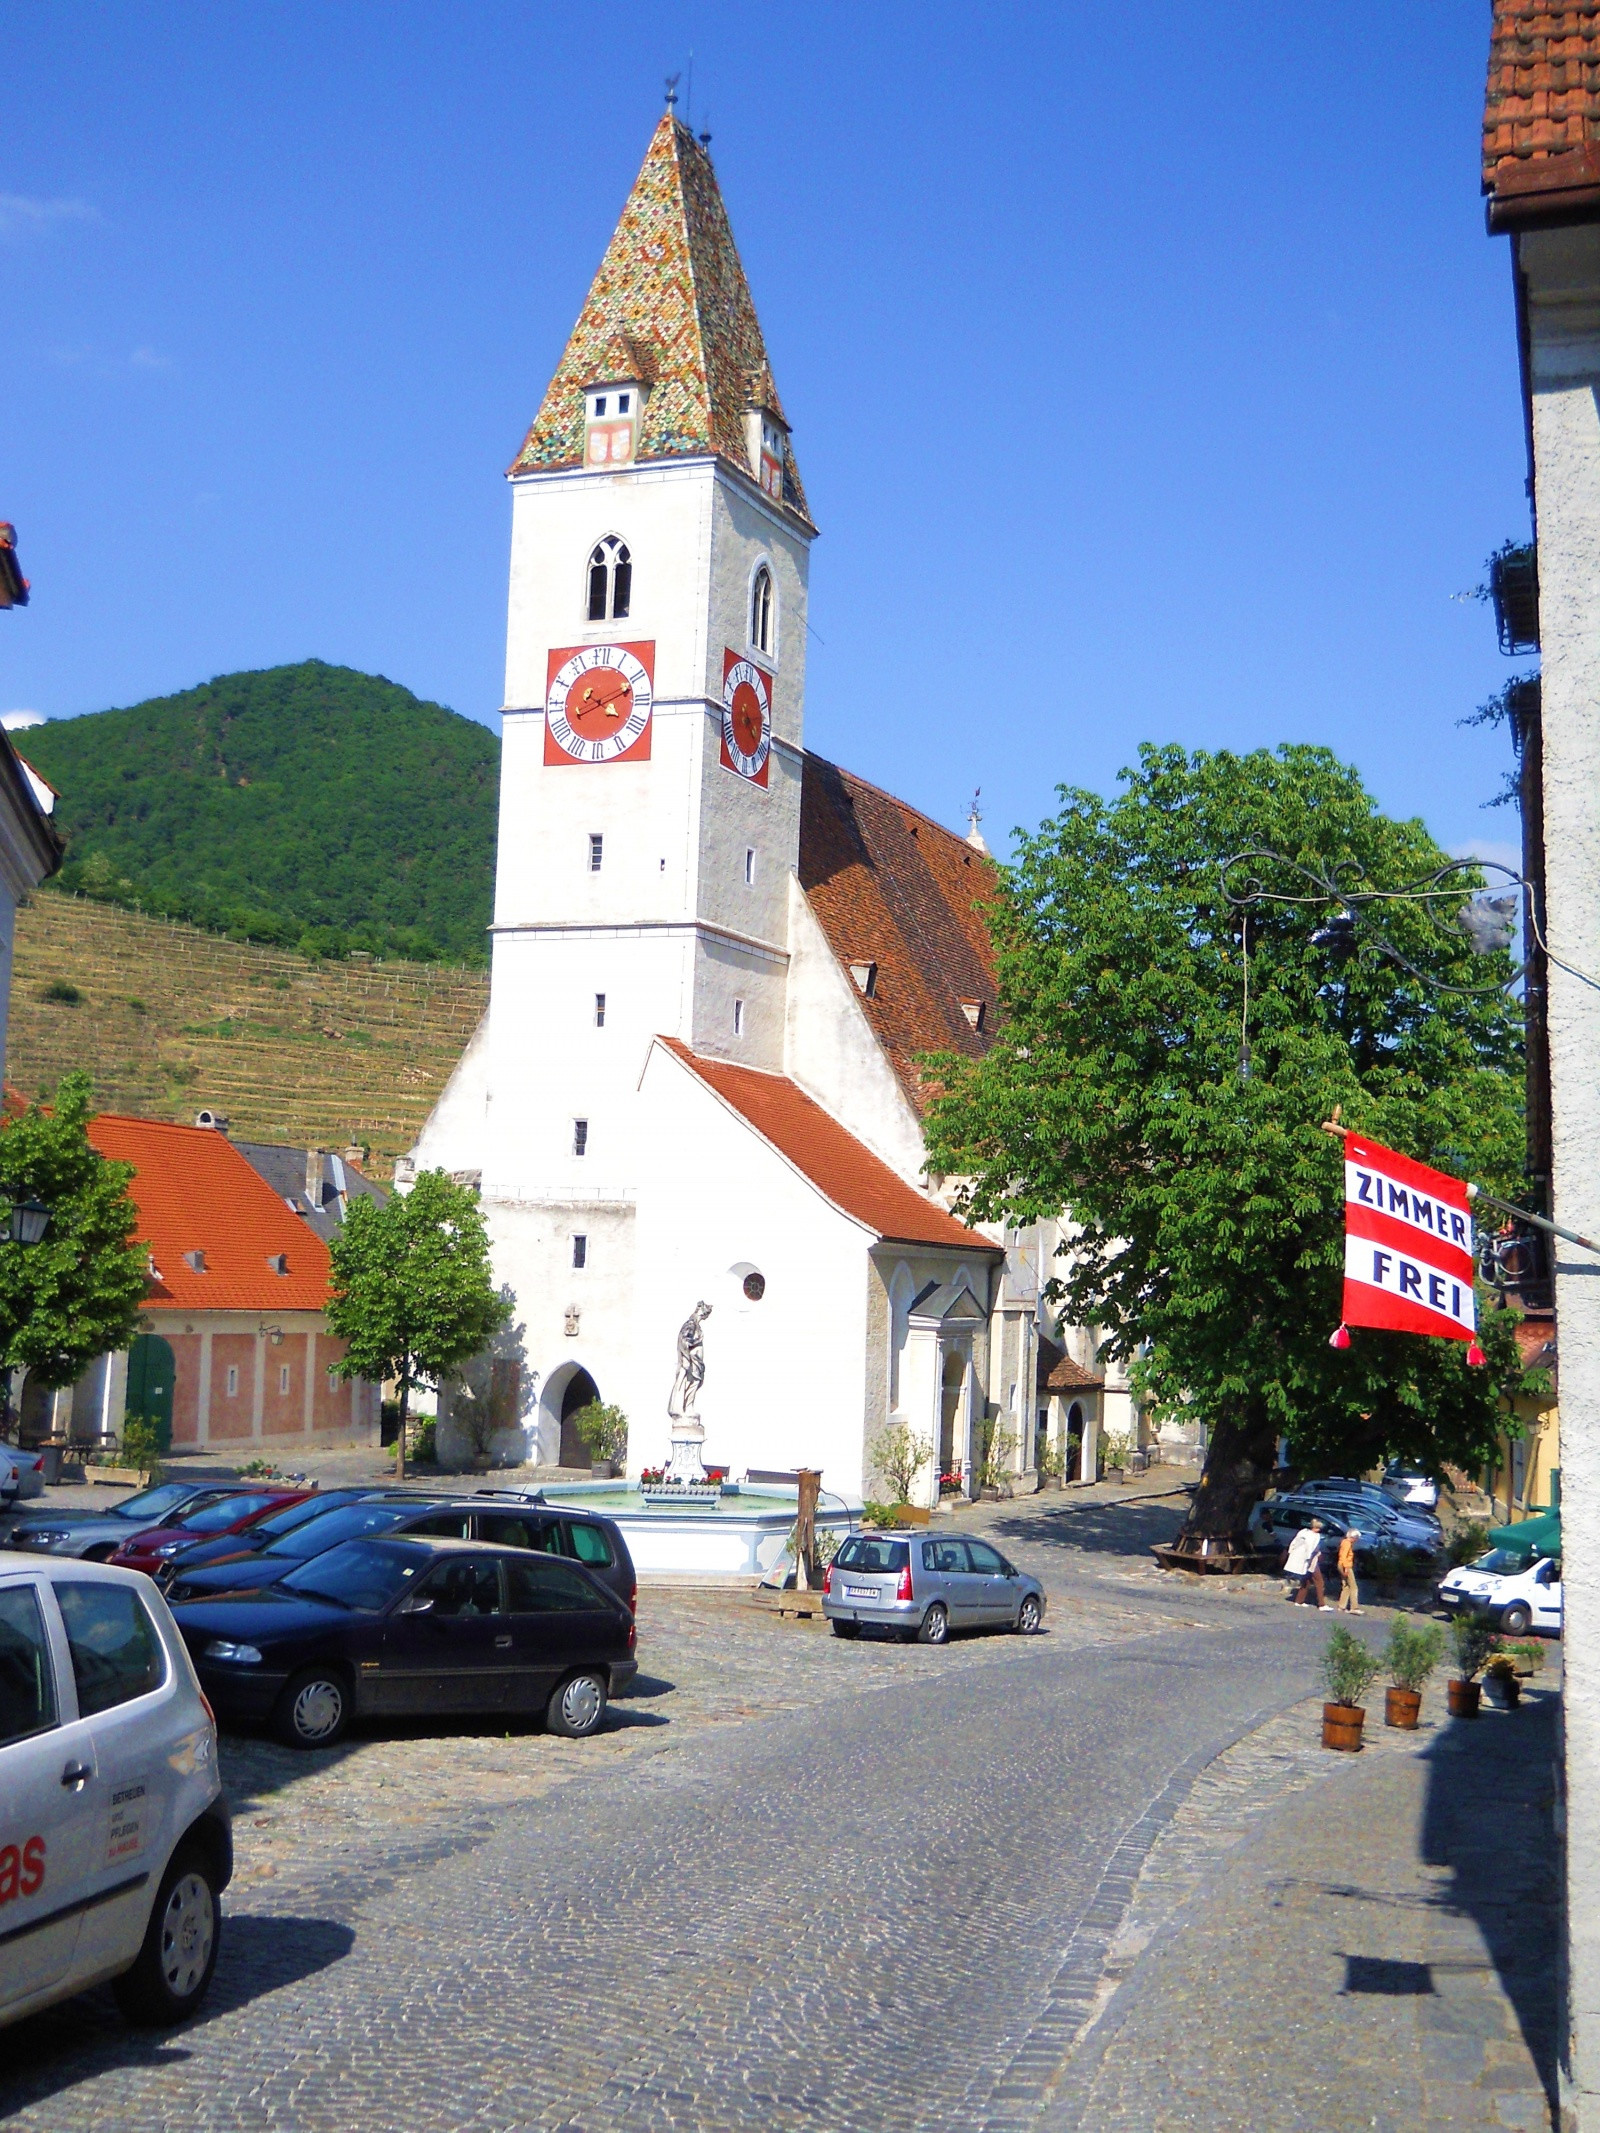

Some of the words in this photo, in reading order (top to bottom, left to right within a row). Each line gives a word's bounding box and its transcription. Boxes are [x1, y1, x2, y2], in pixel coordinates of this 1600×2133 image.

[592, 647, 611, 666] XII
[617, 653, 627, 669] I
[629, 668, 646, 684] II
[634, 692, 651, 706] III
[626, 714, 646, 735] IIII
[1356, 1171, 1466, 1246] ZIMMER
[1373, 1250, 1461, 1318] FREI
